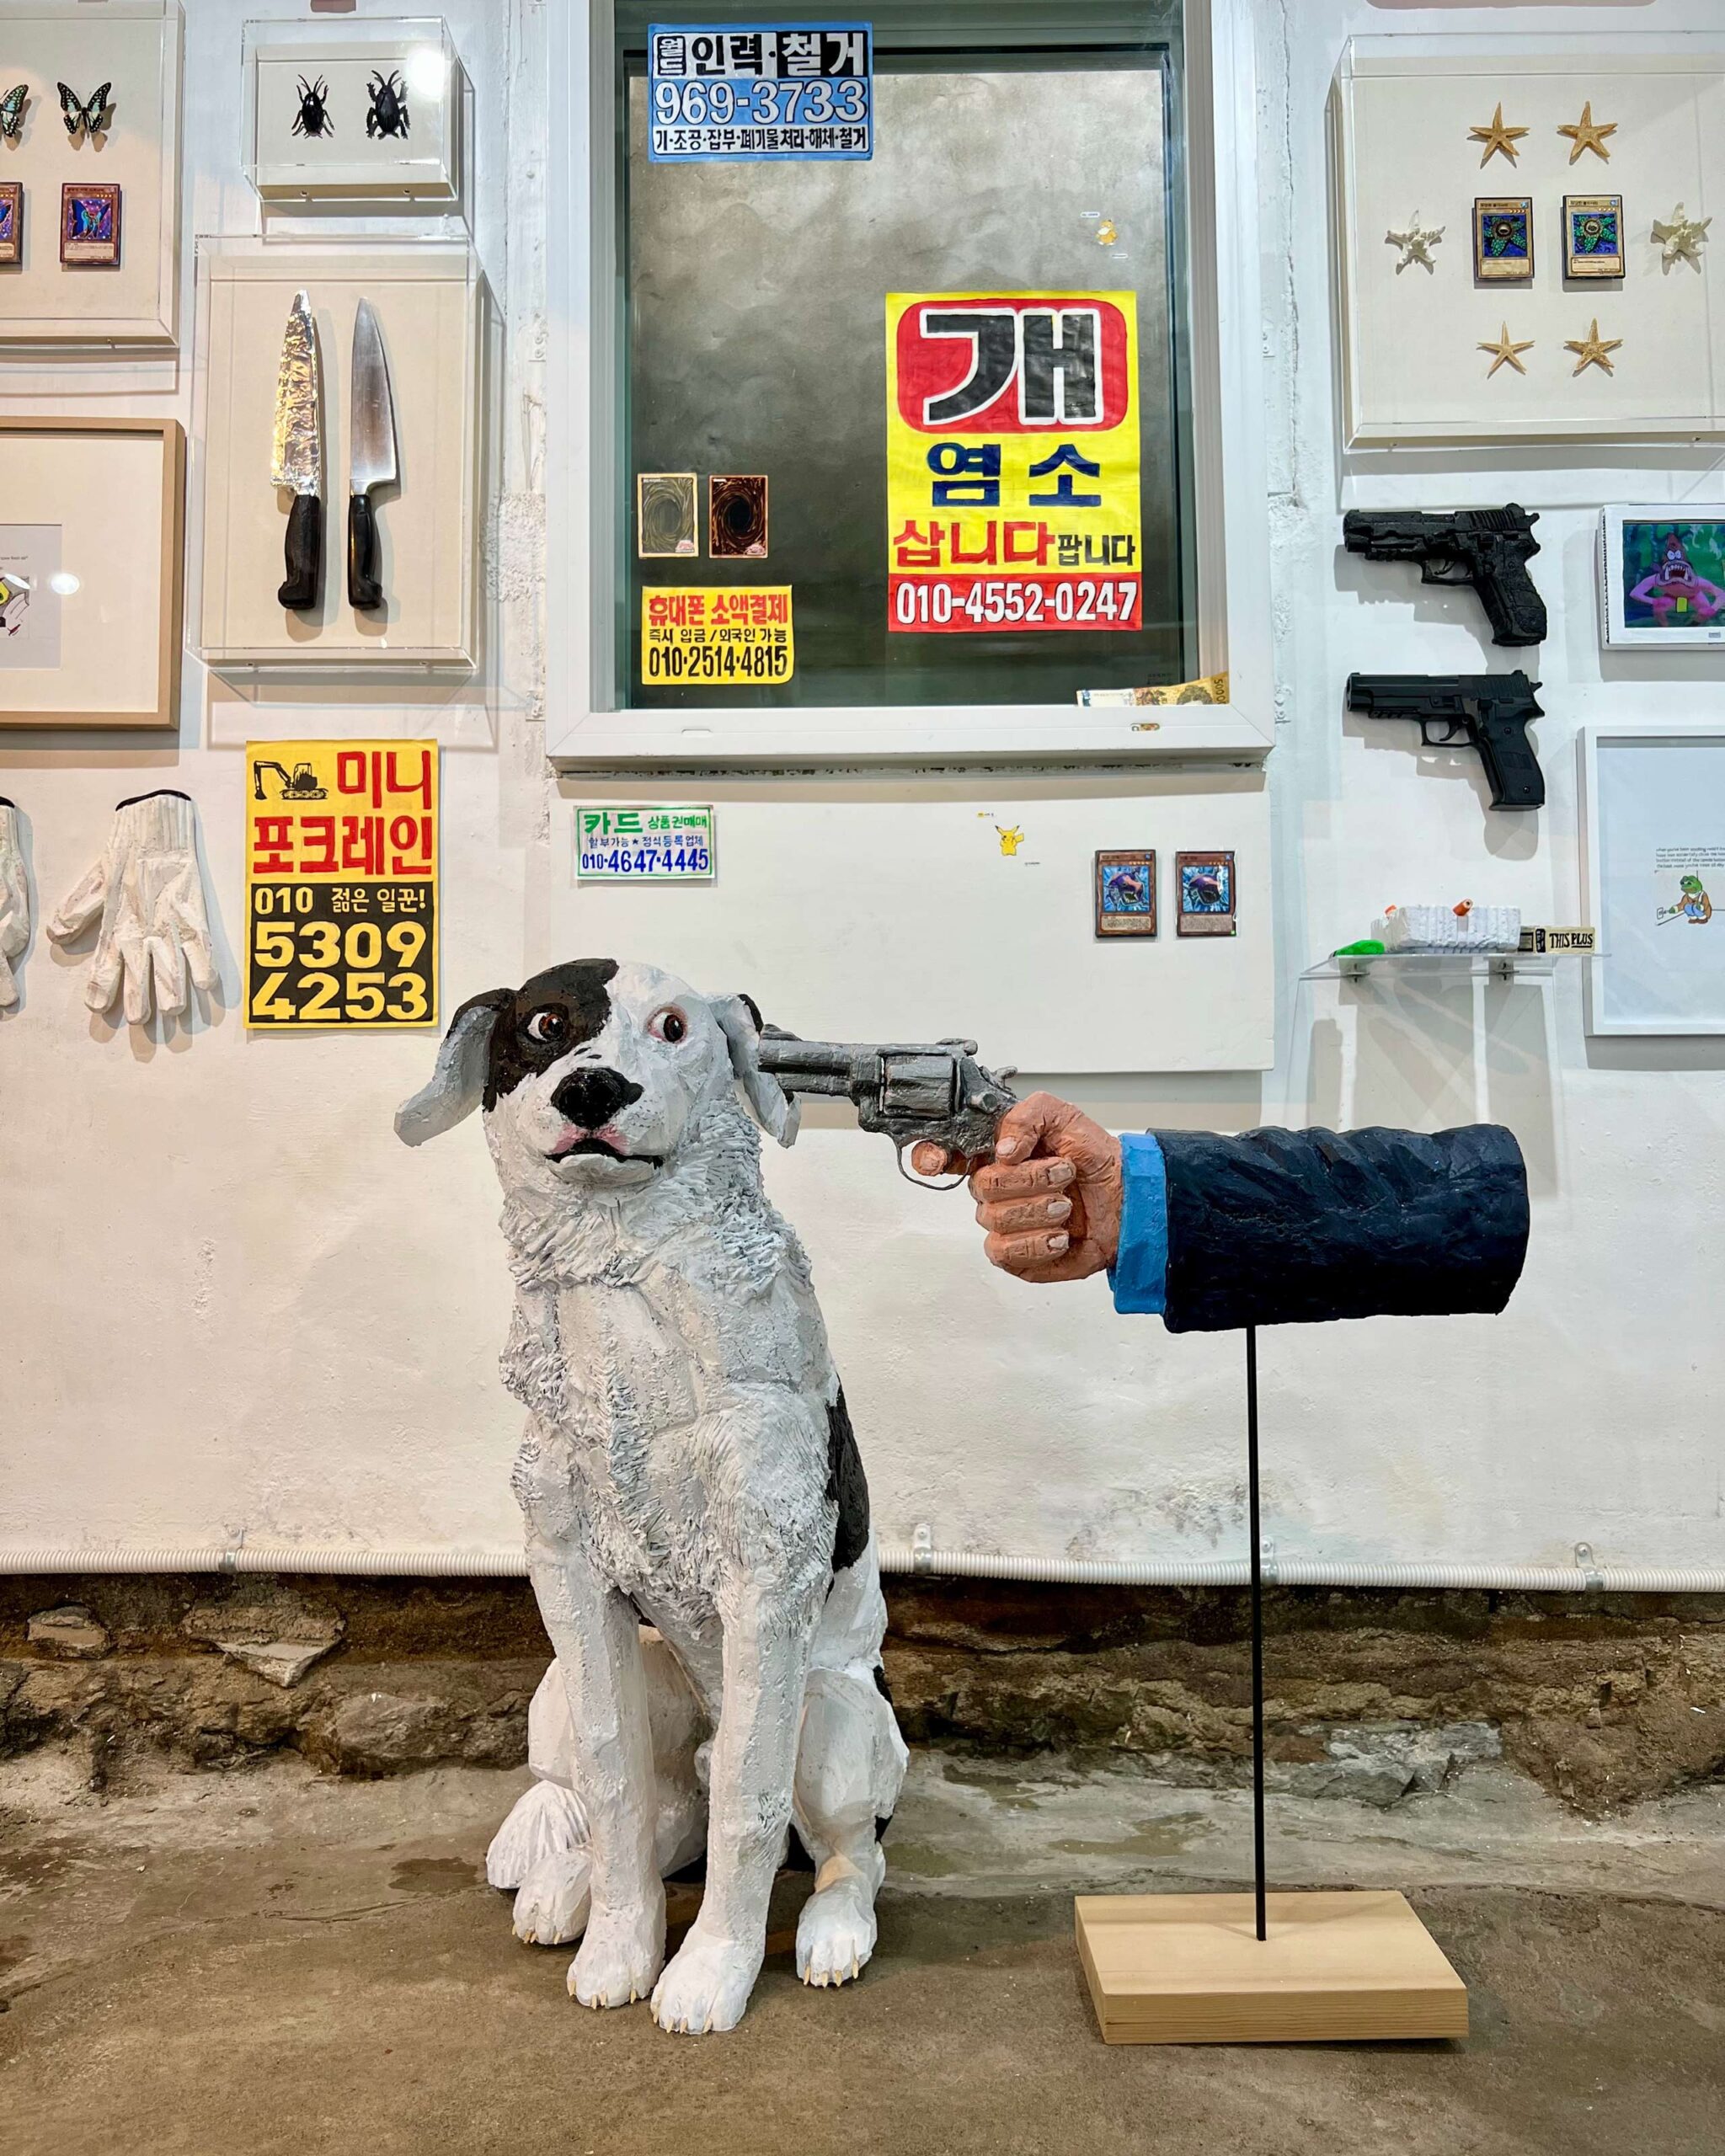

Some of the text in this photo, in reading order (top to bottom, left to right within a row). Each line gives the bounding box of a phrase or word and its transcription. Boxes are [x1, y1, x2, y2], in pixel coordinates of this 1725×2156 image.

[654, 81, 867, 124] 969-3733
[920, 307, 1103, 424] 개
[893, 520, 1136, 567] 삽니다 팝니다
[649, 595, 788, 627] 휴대폰 소액결제
[896, 581, 1137, 624] 010-4552-0247
[649, 629, 673, 643] 즉시
[337, 750, 431, 809] 미니
[254, 815, 432, 875] 포크레인
[584, 812, 644, 835] 카드
[255, 887, 314, 915] 010
[331, 888, 425, 913] 젊은 일꾼!
[254, 921, 425, 968] 5309
[1549, 933, 1570, 949] THIS
[1571, 933, 1593, 945] PLUS
[252, 972, 428, 1020] 4253
